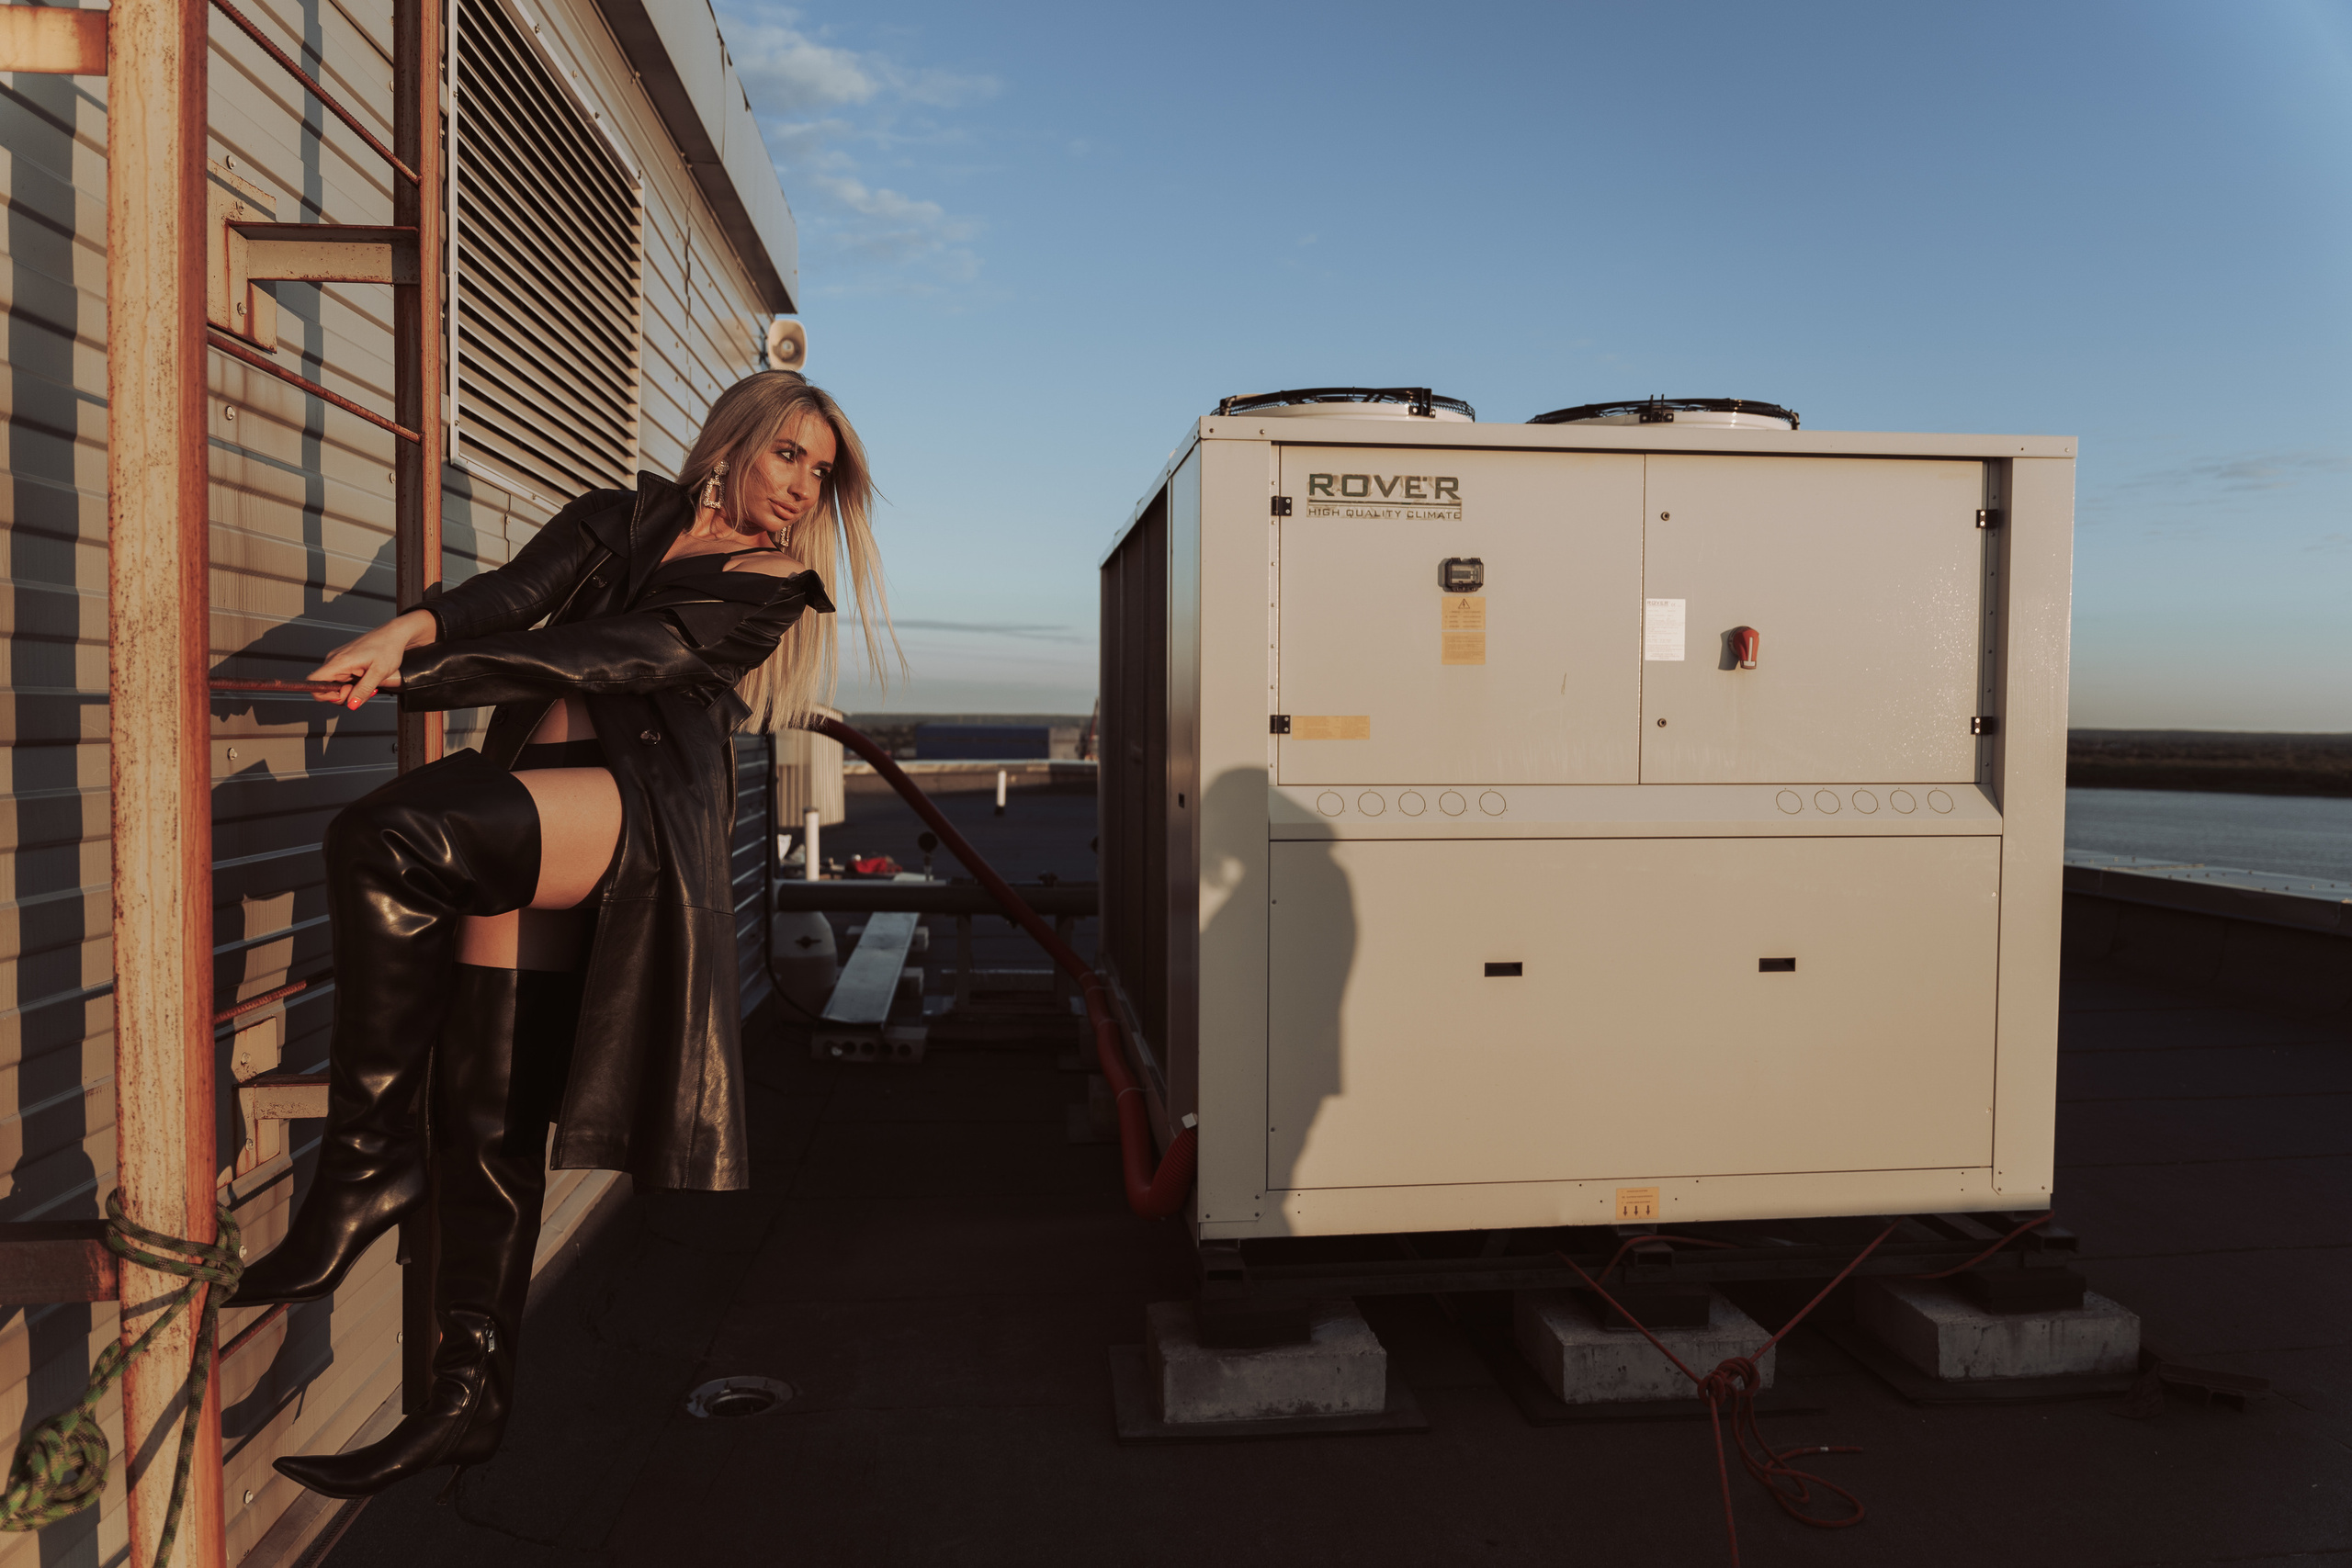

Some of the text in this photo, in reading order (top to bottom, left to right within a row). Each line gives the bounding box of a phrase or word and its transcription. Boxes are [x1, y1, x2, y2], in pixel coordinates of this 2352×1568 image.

[1309, 473, 1461, 500] ROVER
[1308, 508, 1461, 520] HIGH QUALITY CLIMATE
